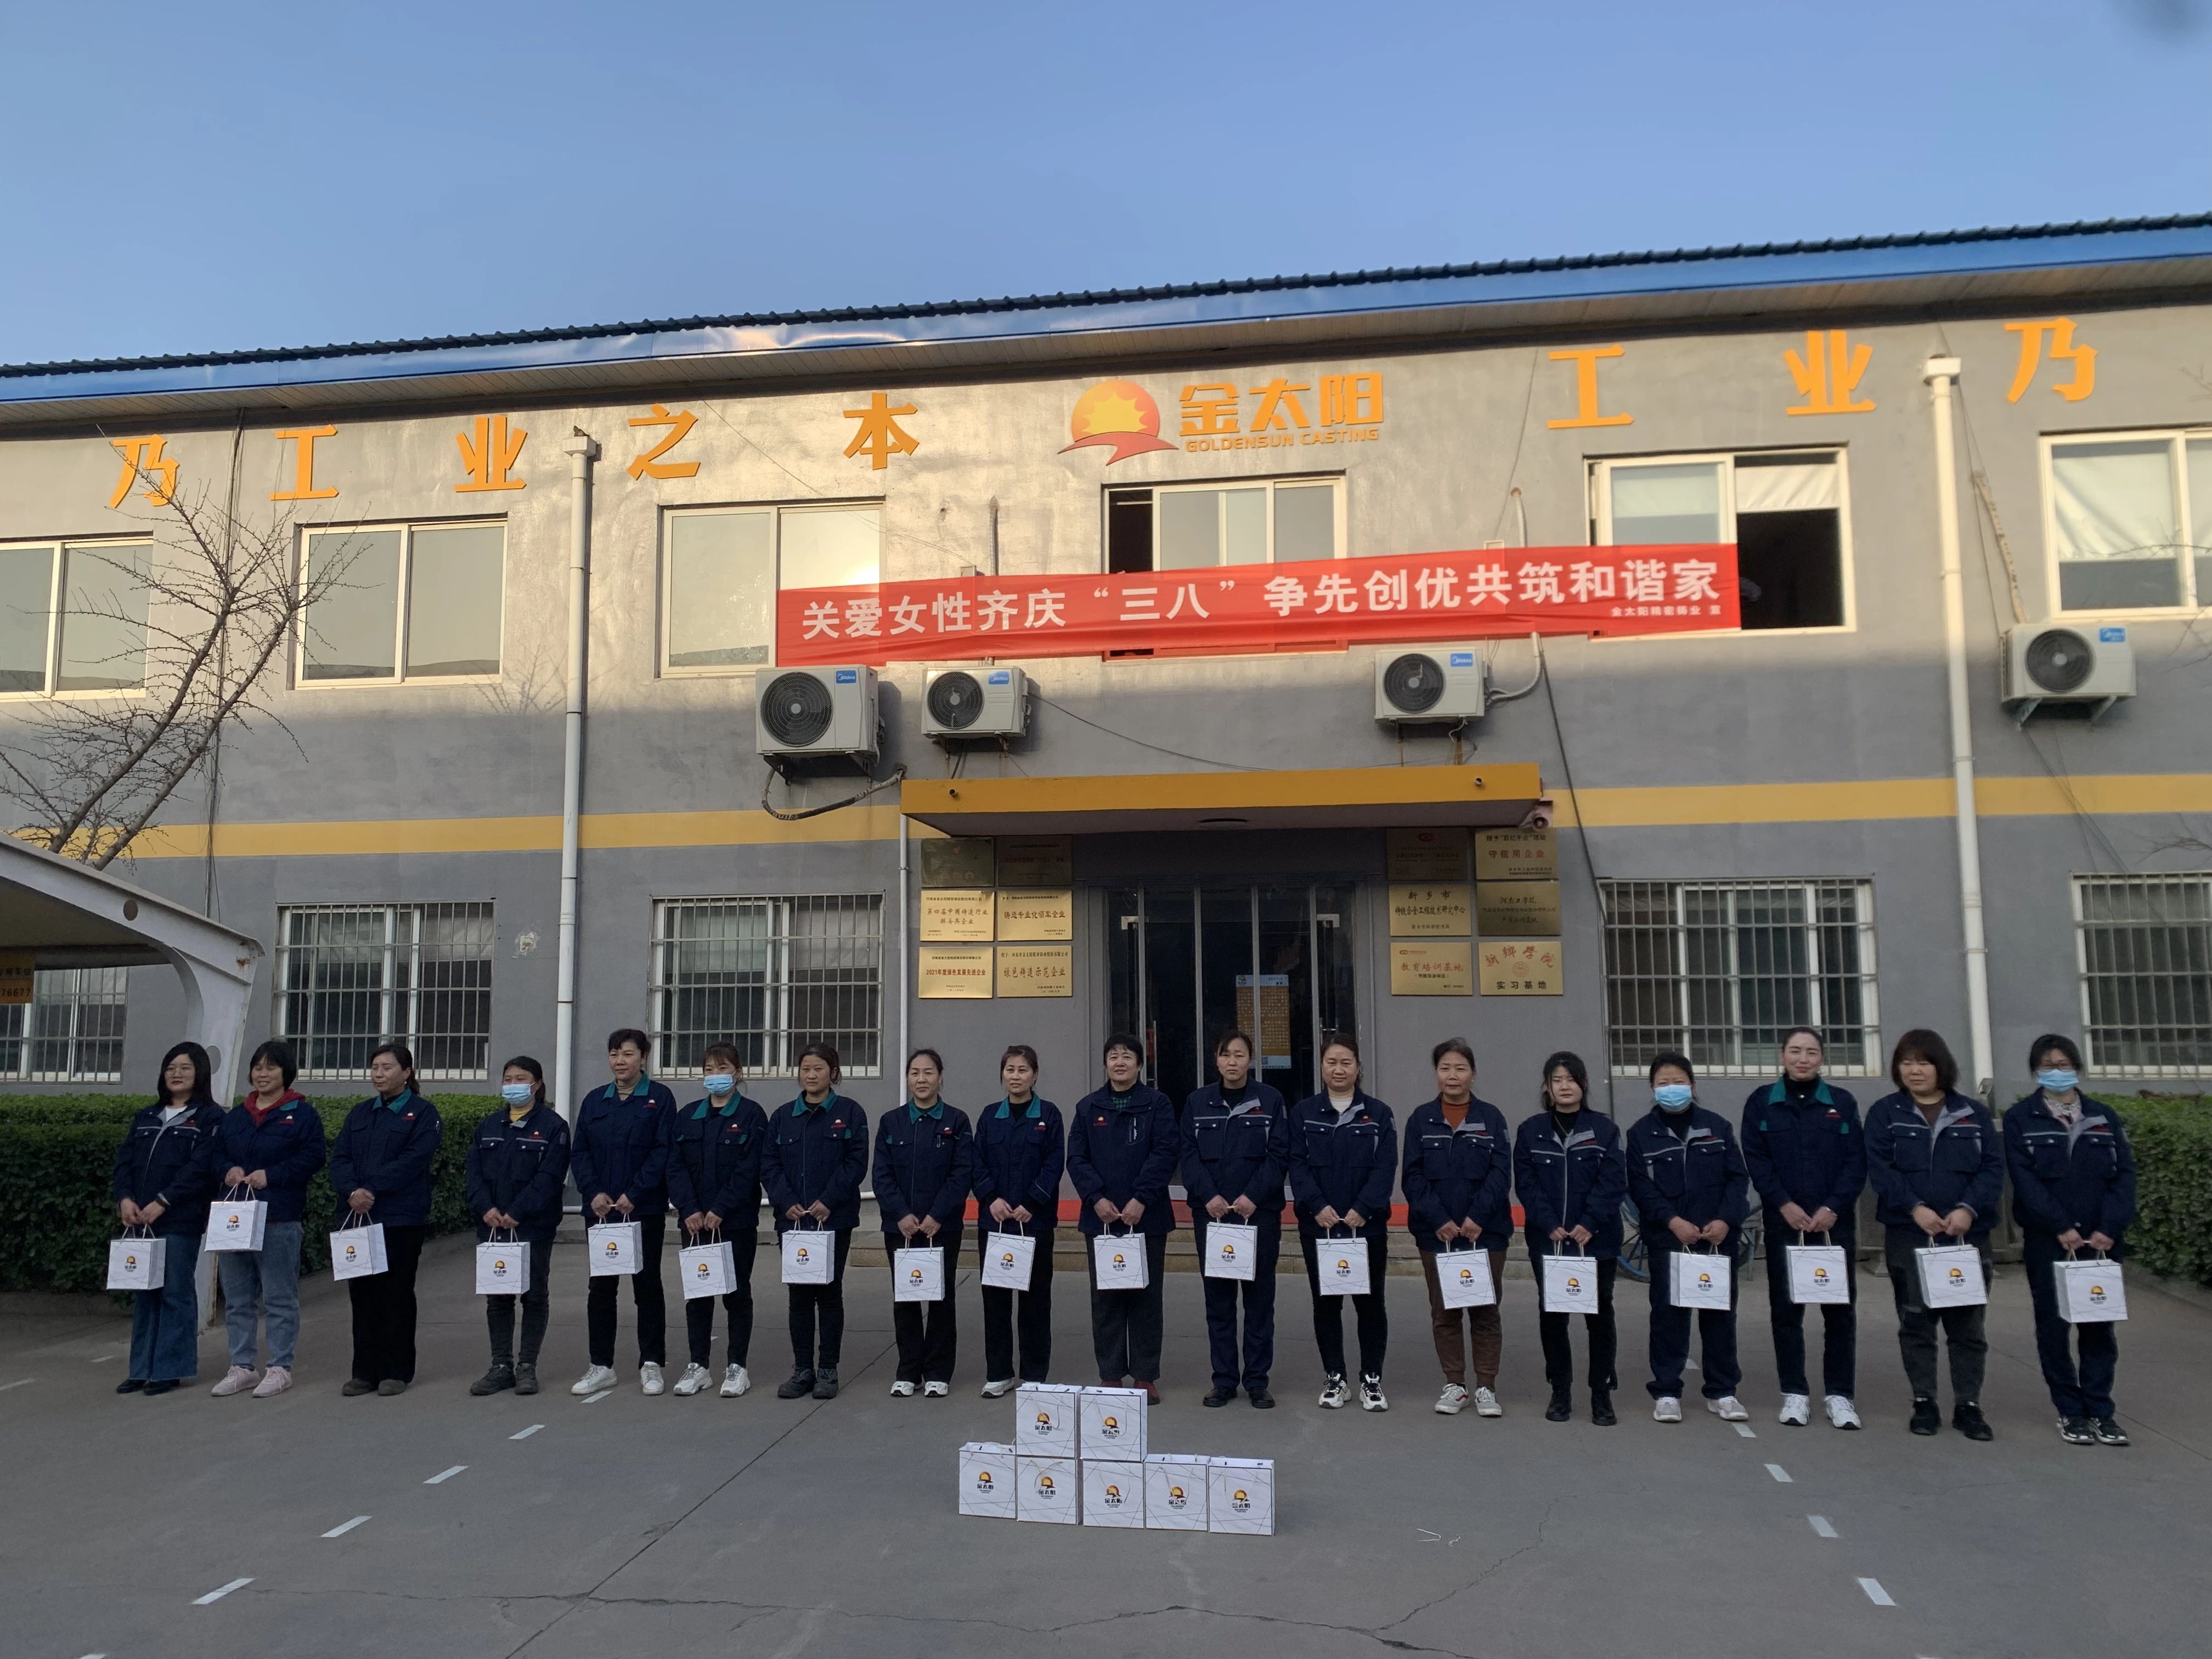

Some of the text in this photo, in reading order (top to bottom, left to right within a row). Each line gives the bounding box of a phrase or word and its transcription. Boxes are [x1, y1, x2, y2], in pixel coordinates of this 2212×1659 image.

[1178, 372, 1384, 436] 金太阳
[1186, 427, 1379, 453] GOLDENSUN CASTING
[1488, 849, 1545, 859] 守信用企业
[1408, 890, 1451, 901] 新乡市
[1004, 966, 1065, 978] 绿色铸造示范企业
[1401, 962, 1464, 972] 教育培训基地
[1496, 980, 1547, 990] 实习基地
